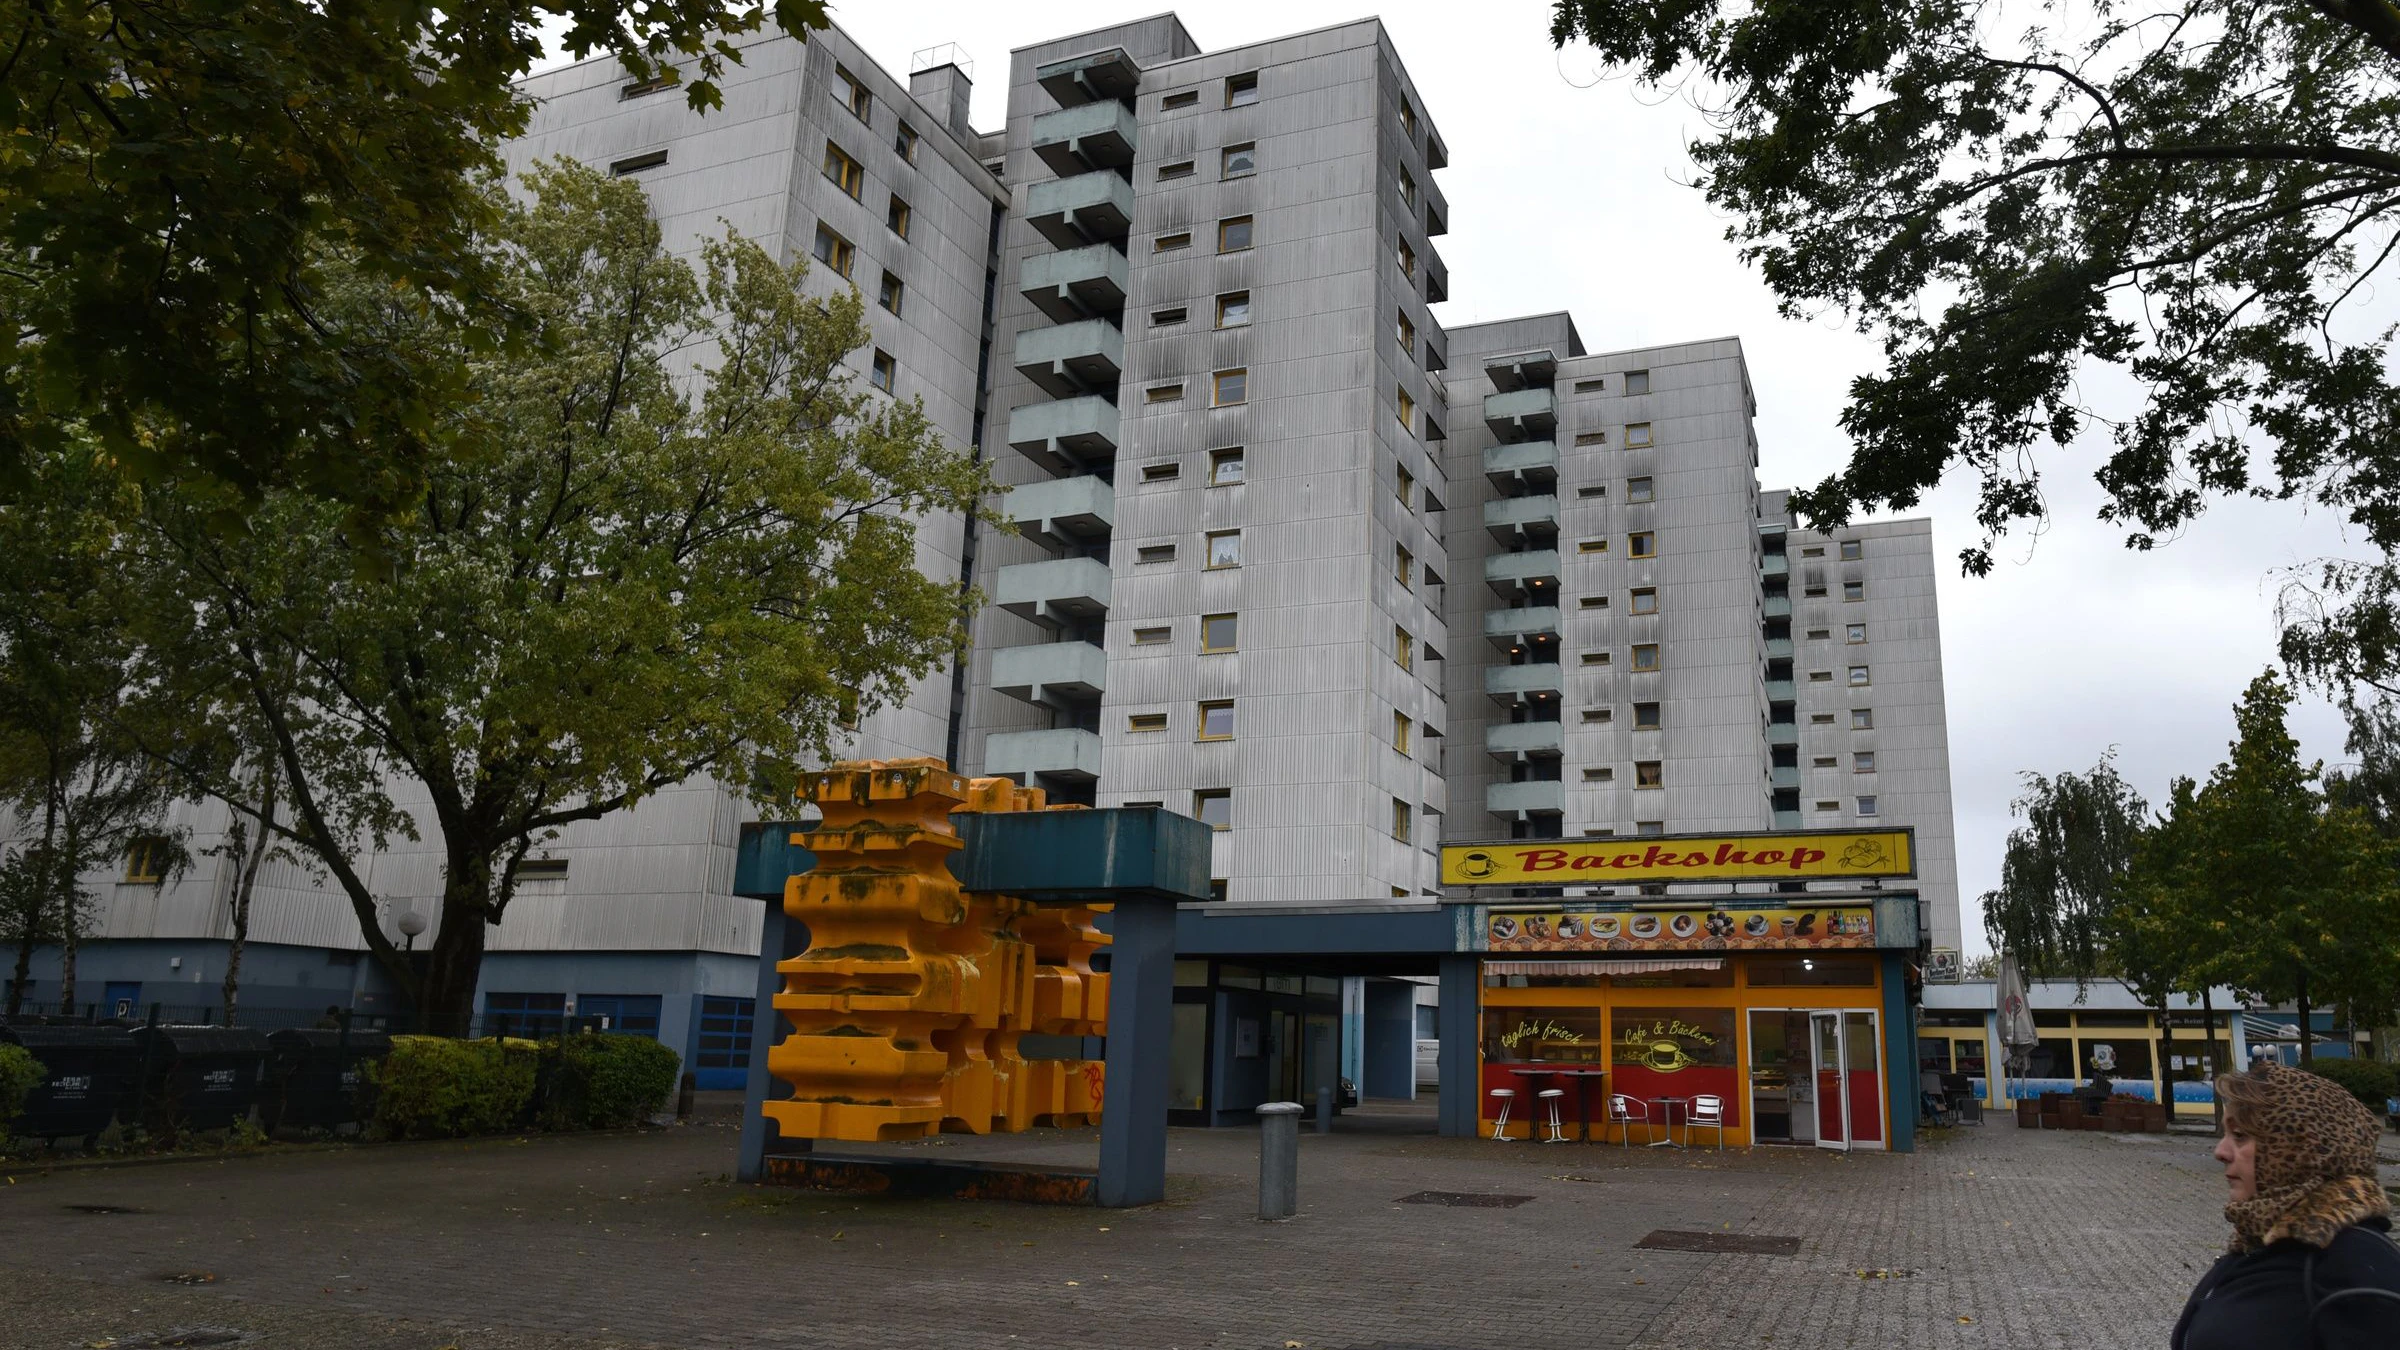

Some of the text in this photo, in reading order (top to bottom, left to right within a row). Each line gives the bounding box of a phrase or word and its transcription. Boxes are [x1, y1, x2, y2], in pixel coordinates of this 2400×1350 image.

[1515, 843, 1826, 872] Backshop
[1501, 1019, 1584, 1048] täglich frisch
[1653, 1021, 1665, 1035] &
[1668, 1020, 1720, 1046] Bäckerei
